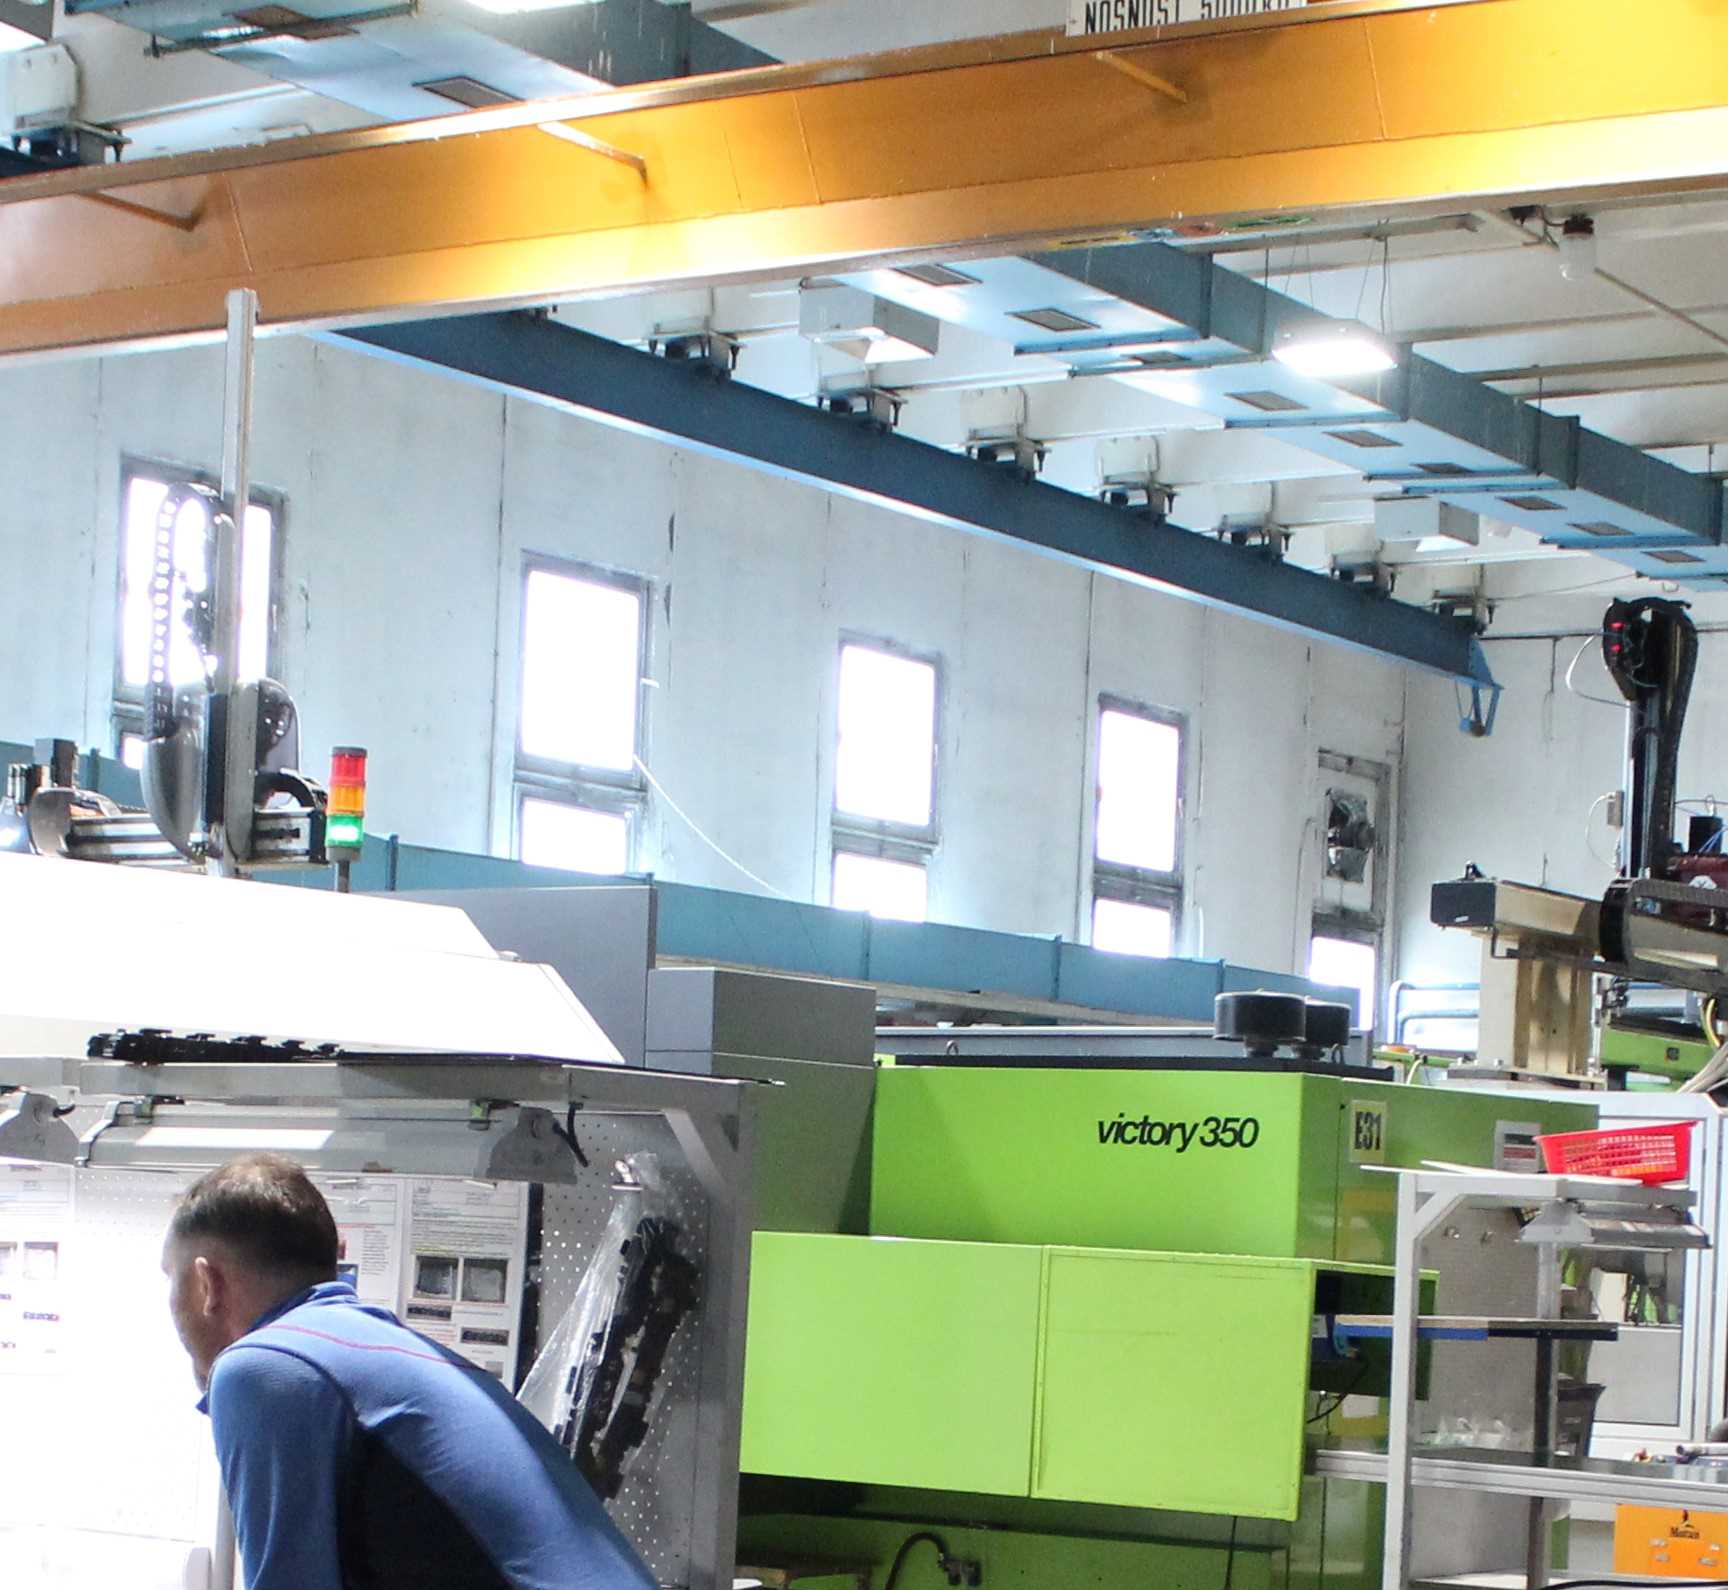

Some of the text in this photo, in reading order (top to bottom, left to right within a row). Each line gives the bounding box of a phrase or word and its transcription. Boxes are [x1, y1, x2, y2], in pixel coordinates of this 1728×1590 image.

[1098, 1113, 1260, 1153] victory 350
[1354, 1111, 1382, 1150] E31
